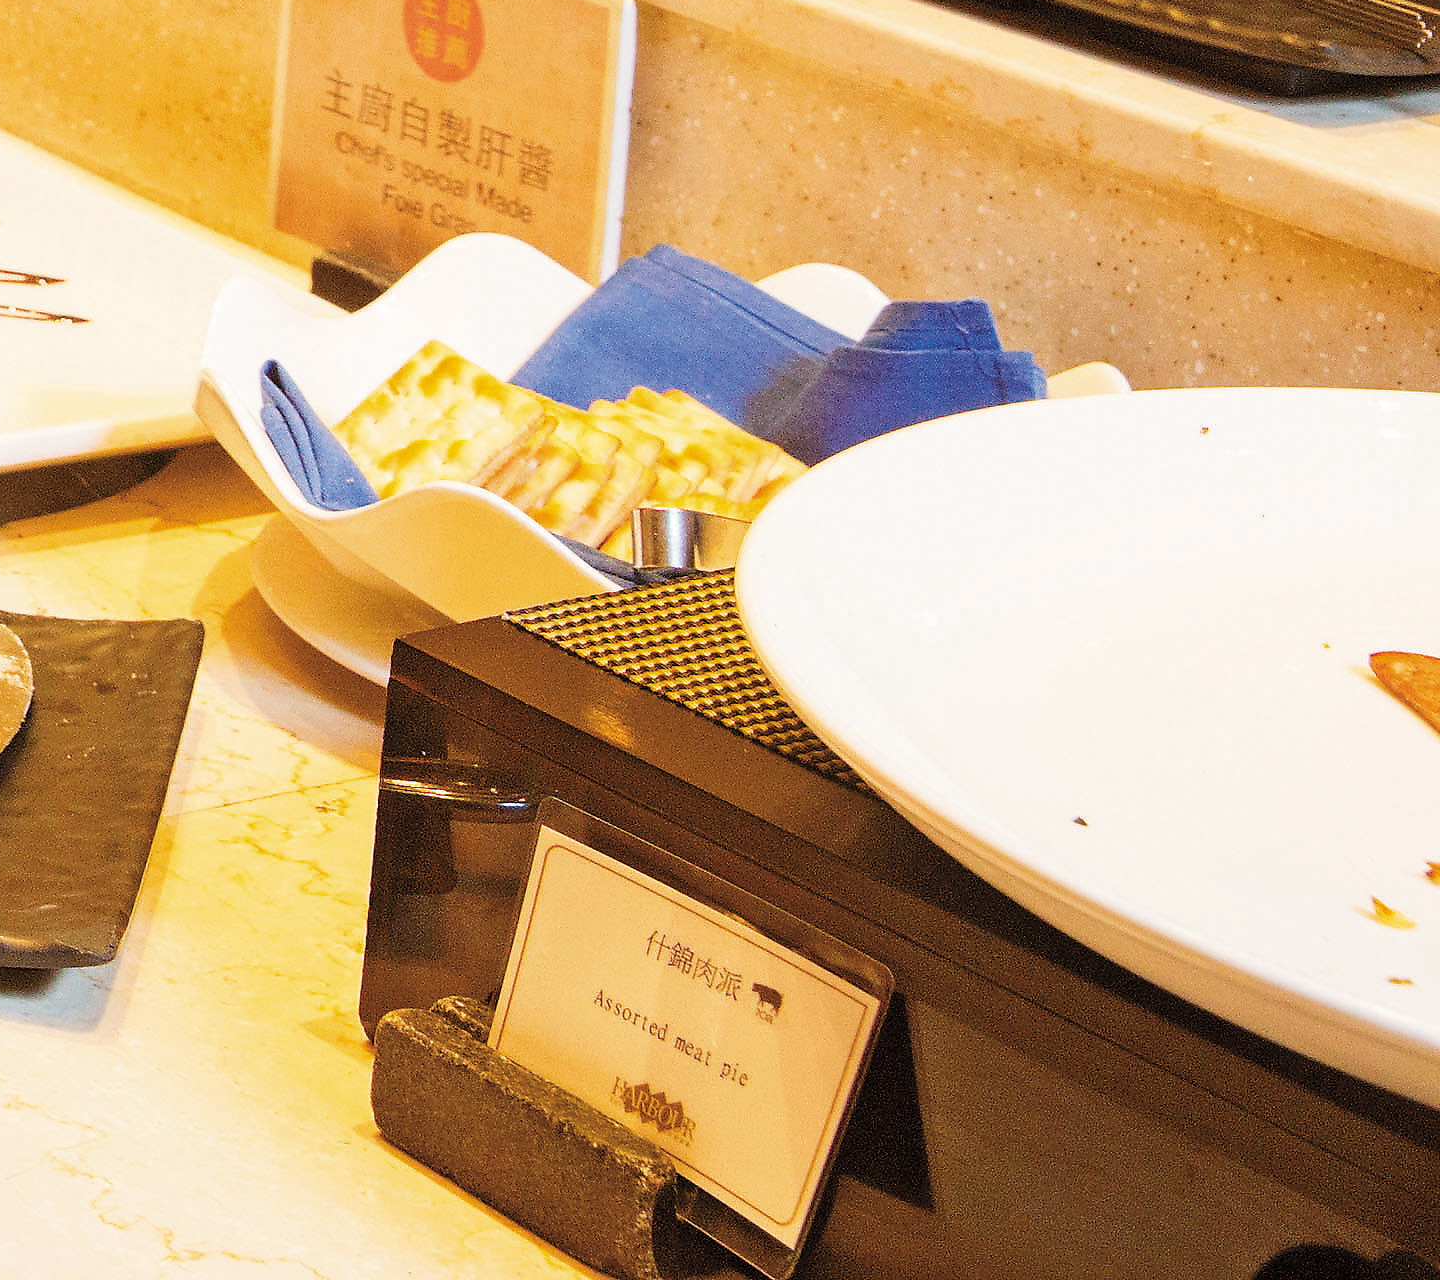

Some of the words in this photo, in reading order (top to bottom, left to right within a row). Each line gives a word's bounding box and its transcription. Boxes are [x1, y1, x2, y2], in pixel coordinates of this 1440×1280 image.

[320, 68, 554, 191] 主廚自製肝醬
[335, 130, 395, 172] Chef's
[401, 158, 470, 199] special
[476, 181, 533, 224] Made
[646, 930, 743, 1001] 什錦肉派
[594, 989, 668, 1041] Assorted
[674, 1036, 712, 1067] meat
[720, 1062, 750, 1087] pie
